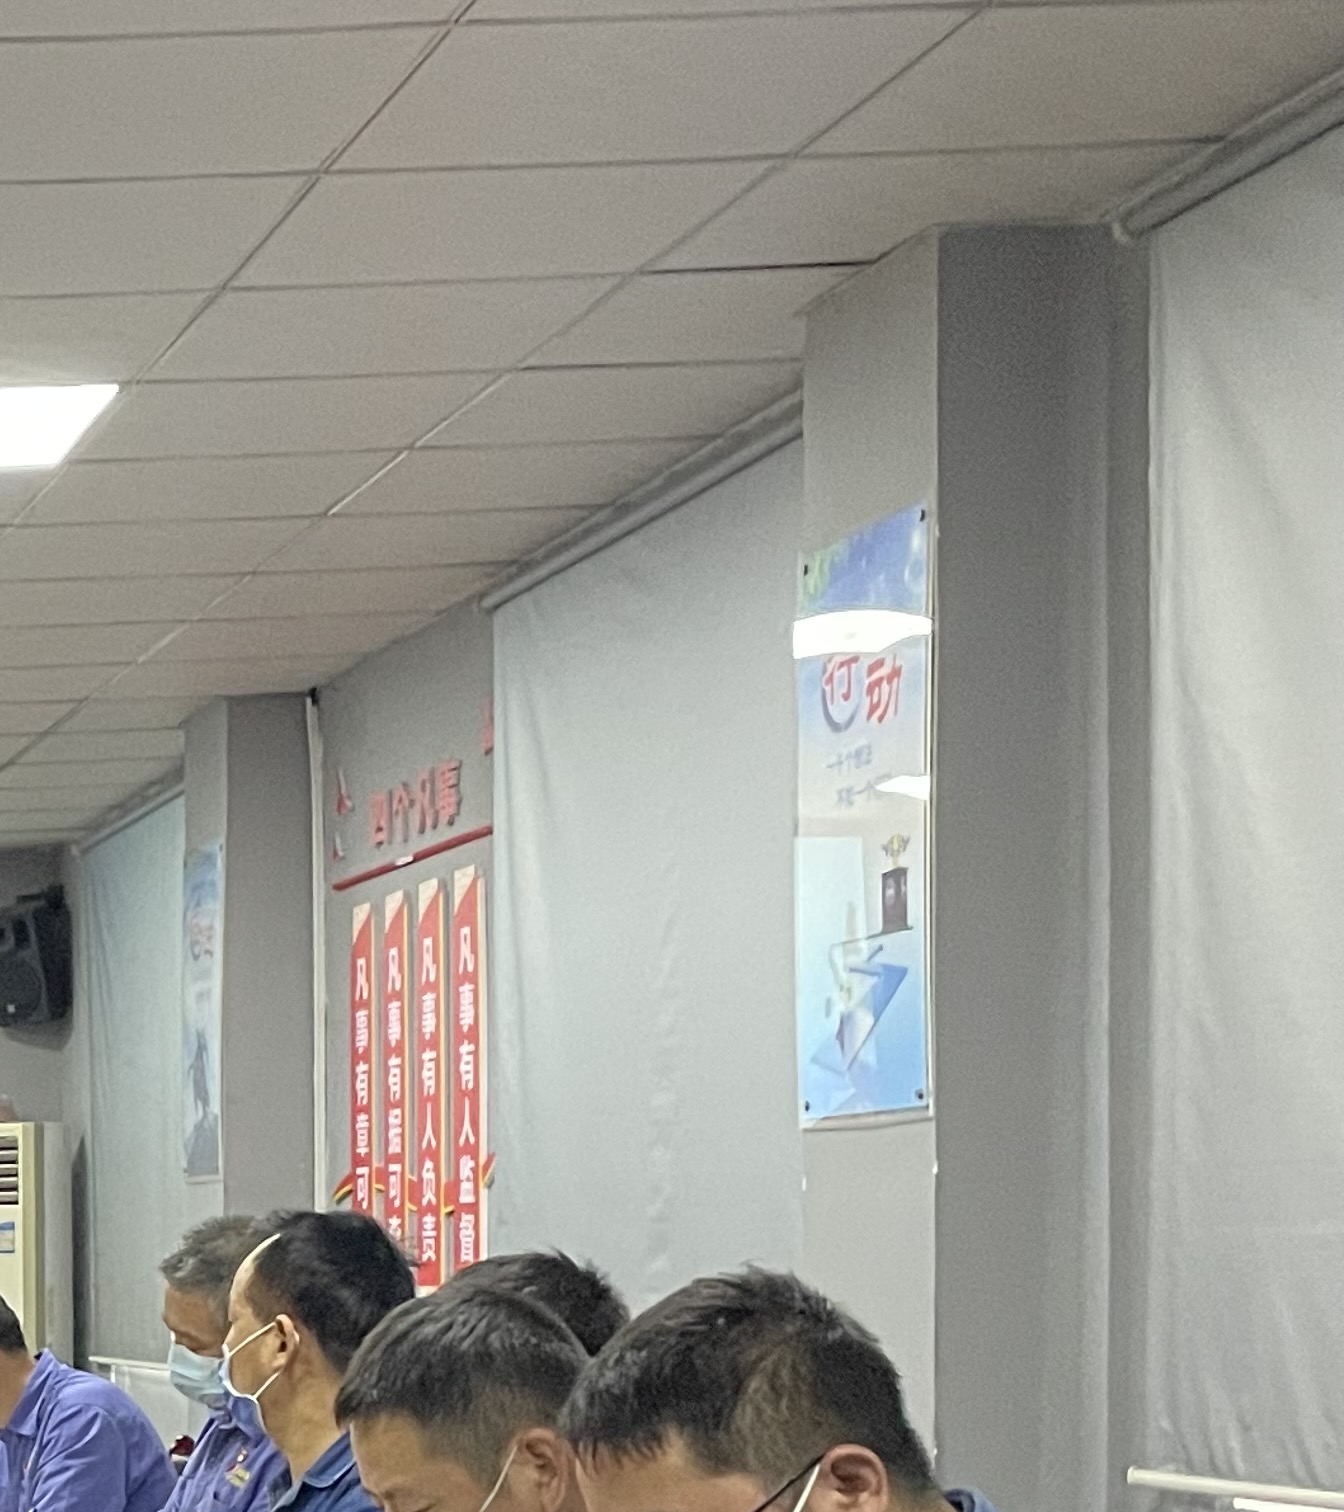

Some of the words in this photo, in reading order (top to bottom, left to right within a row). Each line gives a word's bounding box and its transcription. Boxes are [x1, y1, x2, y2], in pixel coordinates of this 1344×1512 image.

[823, 653, 903, 724] 行动
[355, 957, 369, 1210] 凡事有章可
[421, 936, 437, 1263] 凡事有人负责
[458, 926, 476, 1263] 凡事有人监督
